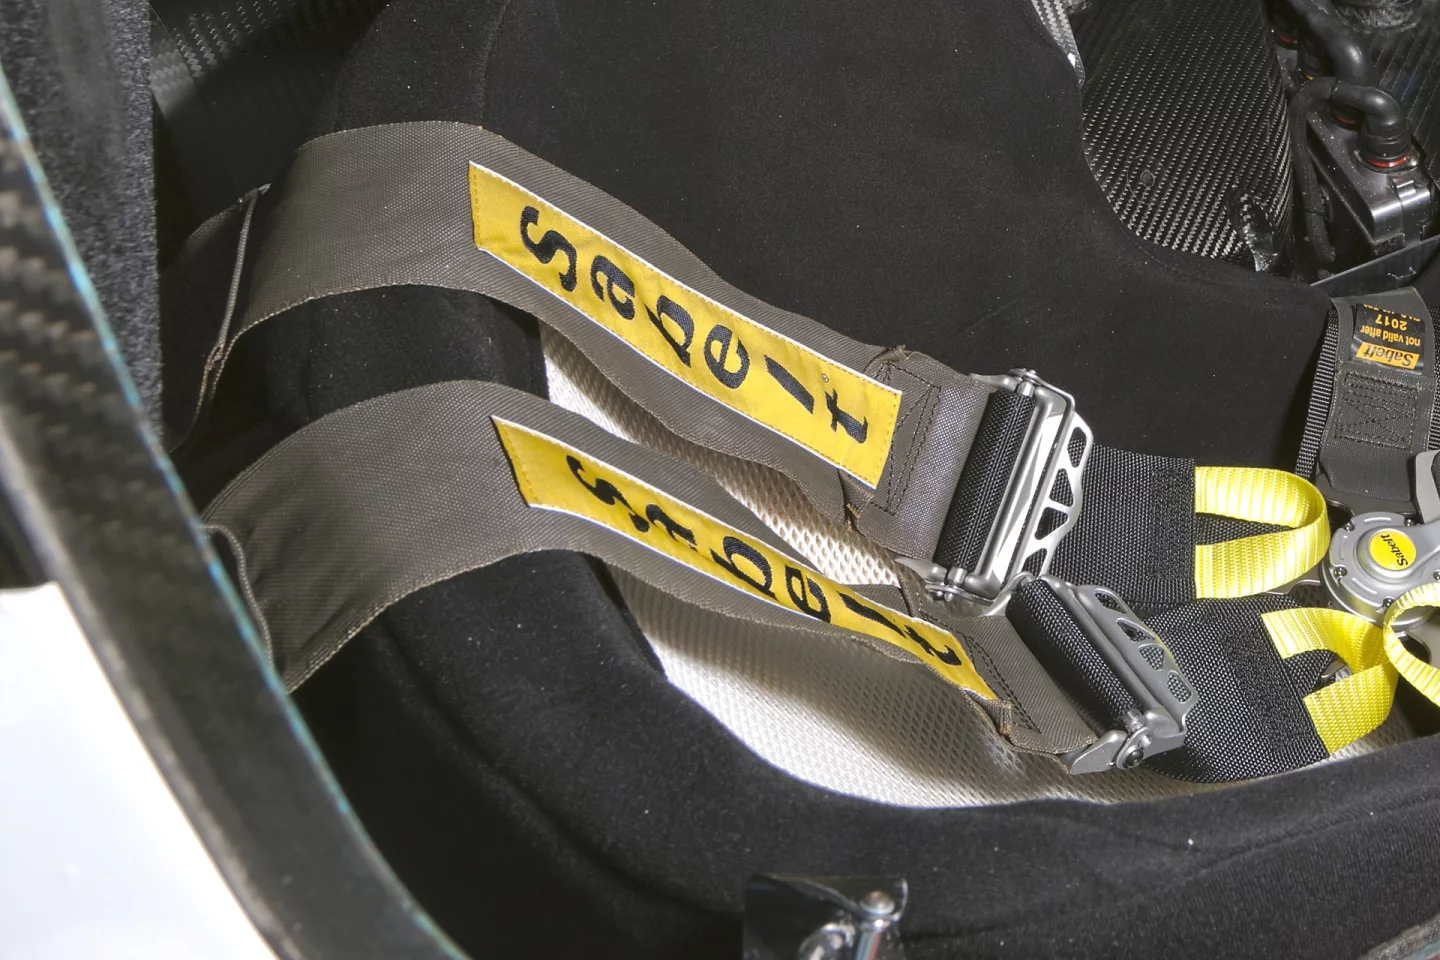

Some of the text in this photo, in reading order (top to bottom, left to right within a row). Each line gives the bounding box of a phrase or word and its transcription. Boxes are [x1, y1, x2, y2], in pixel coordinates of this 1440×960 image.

[521, 206, 869, 444] Sabelt
[1375, 314, 1408, 331] 2017
[1360, 325, 1420, 346] not valid after
[1363, 345, 1413, 366] Sabelt
[1380, 534, 1408, 566] Sabelt
